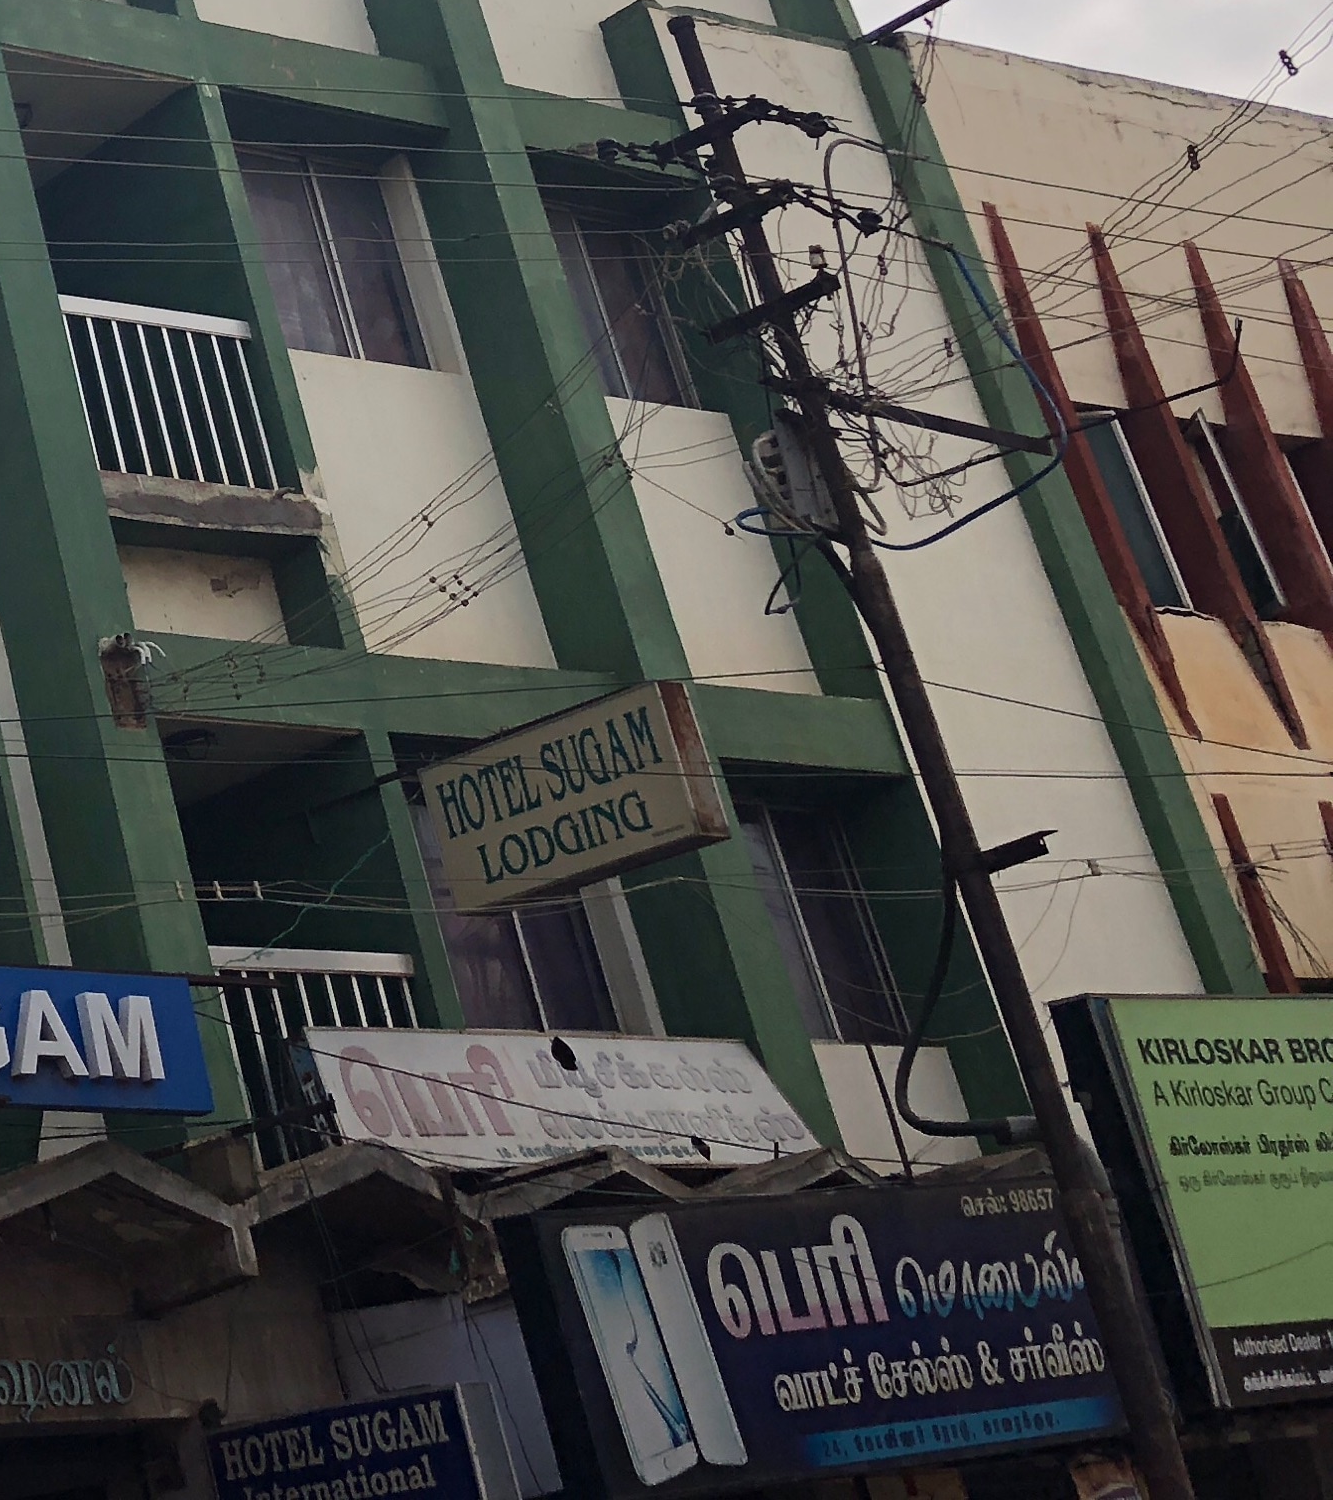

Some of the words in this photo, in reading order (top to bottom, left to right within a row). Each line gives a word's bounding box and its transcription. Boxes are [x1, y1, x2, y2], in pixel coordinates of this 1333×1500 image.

[435, 755, 542, 840] HOTEL
[539, 705, 663, 802] SUGAM
[477, 790, 653, 885] LODGING
[1137, 1037, 1285, 1066] KIRLOSKAR
[1153, 1080, 1170, 1107] A
[1170, 1079, 1254, 1108] Kirloskar
[1257, 1078, 1317, 1111] Group
[978, 1339, 1005, 1387] &
[1233, 1334, 1290, 1357] Authorised
[1288, 1331, 1321, 1353] Dealer
[218, 1424, 326, 1482] HOTEL
[329, 1399, 451, 1462] SUGAM
